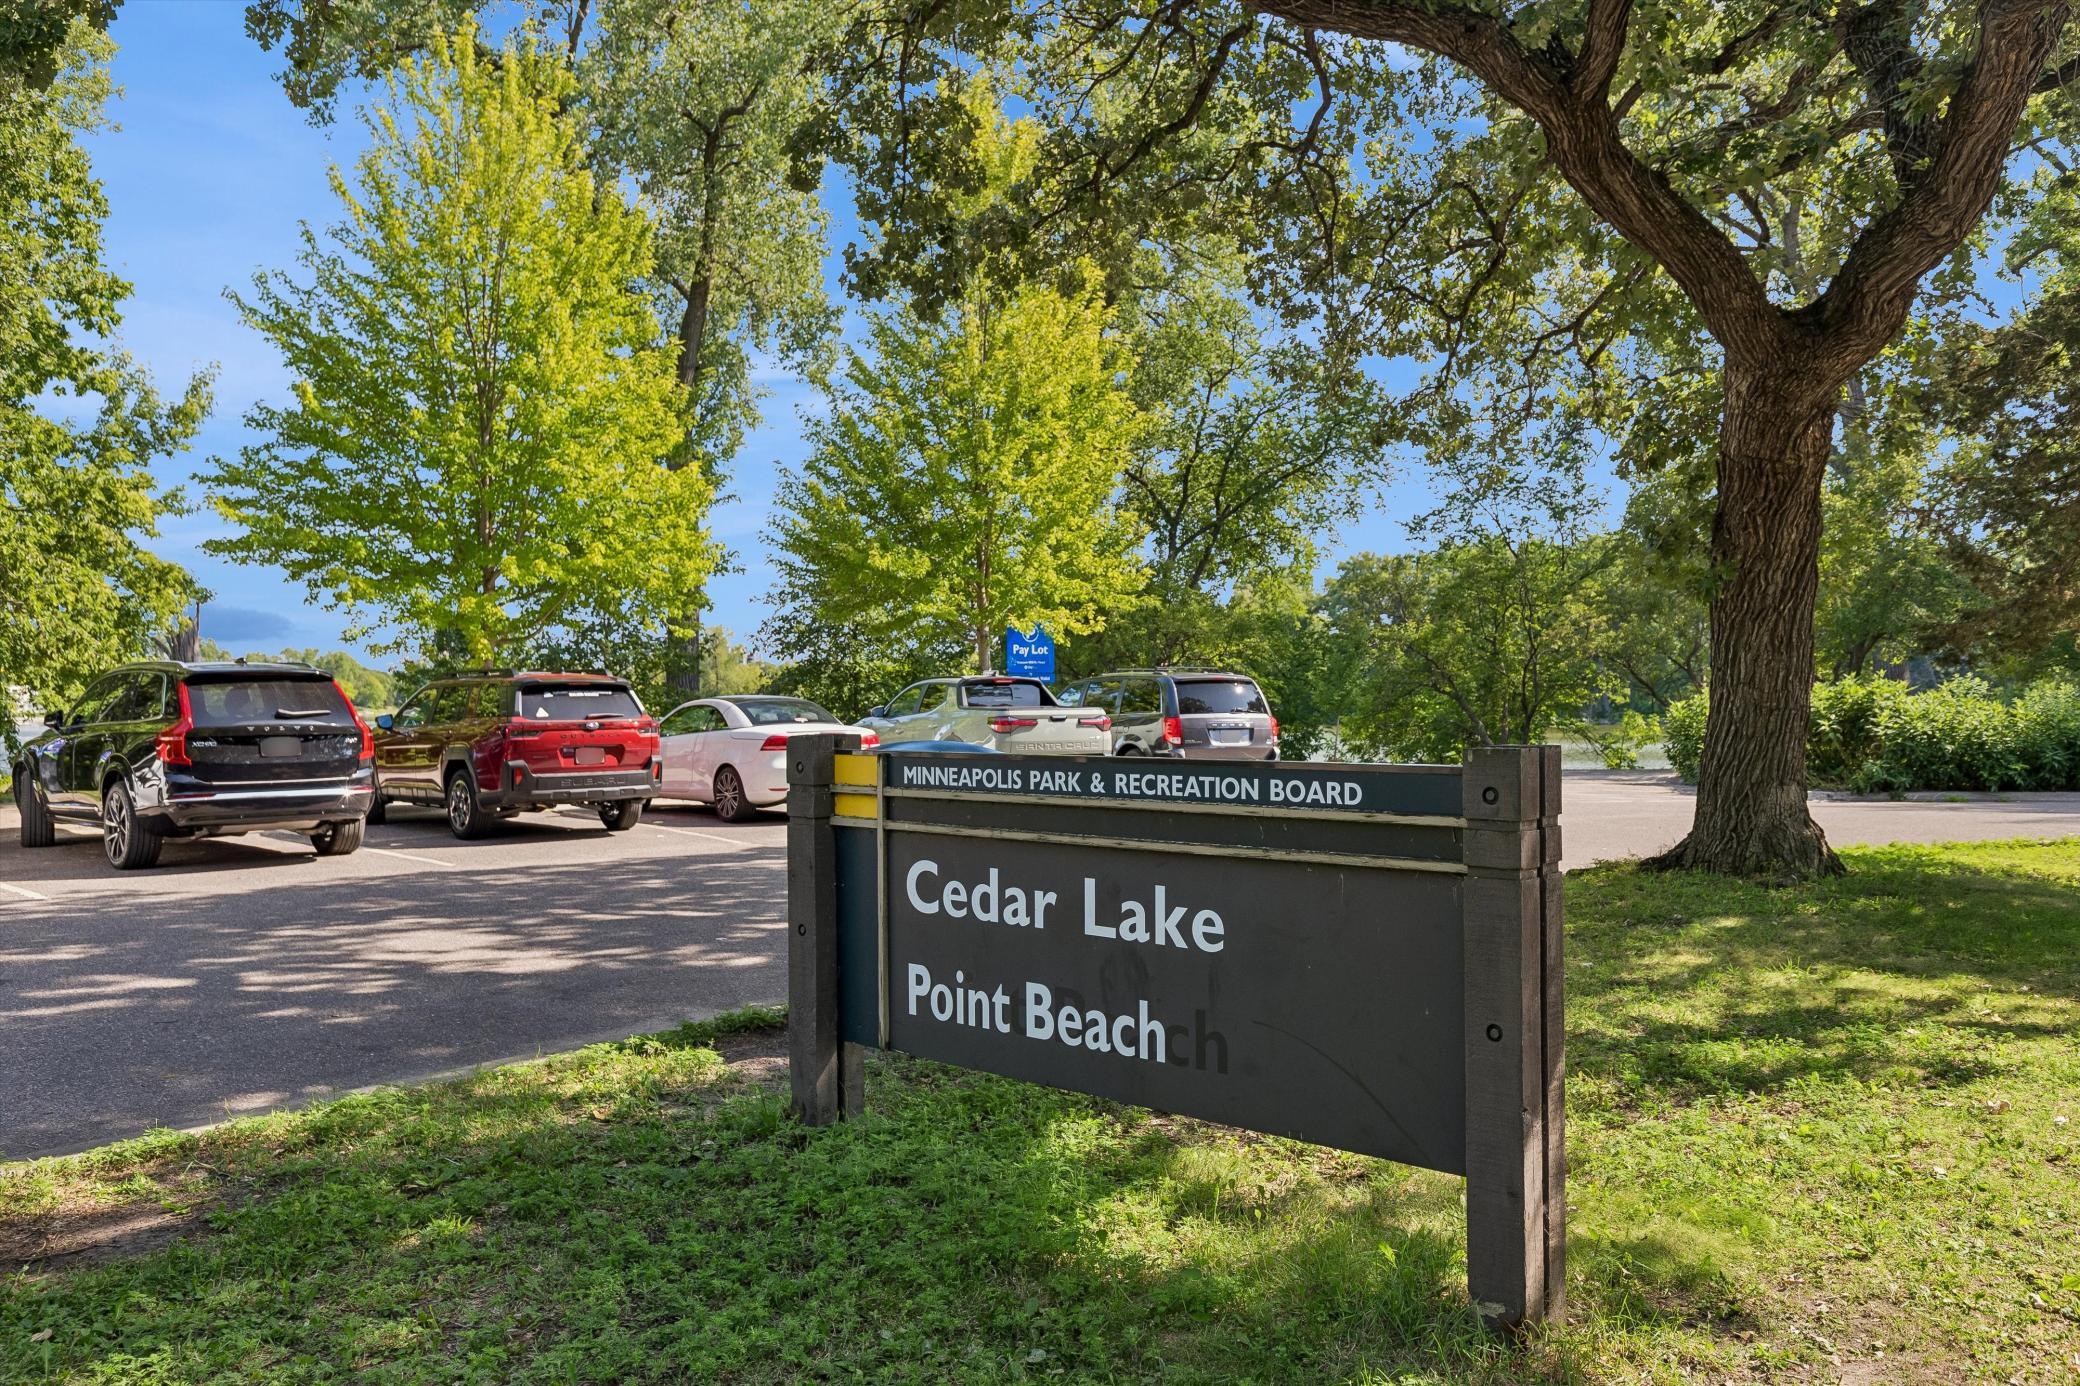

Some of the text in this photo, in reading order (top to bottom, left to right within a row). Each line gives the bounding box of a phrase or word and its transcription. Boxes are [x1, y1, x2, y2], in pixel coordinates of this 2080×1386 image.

[1012, 644, 1049, 657] Pay Lot
[1015, 743, 1062, 751] SANTA
[903, 766, 1364, 806] MINNEAPOLIS PARK & RECREATION BOARD
[906, 859, 1226, 953] Cedar Lake
[907, 963, 1011, 1033] Point
[1025, 981, 1167, 1063] Beach
